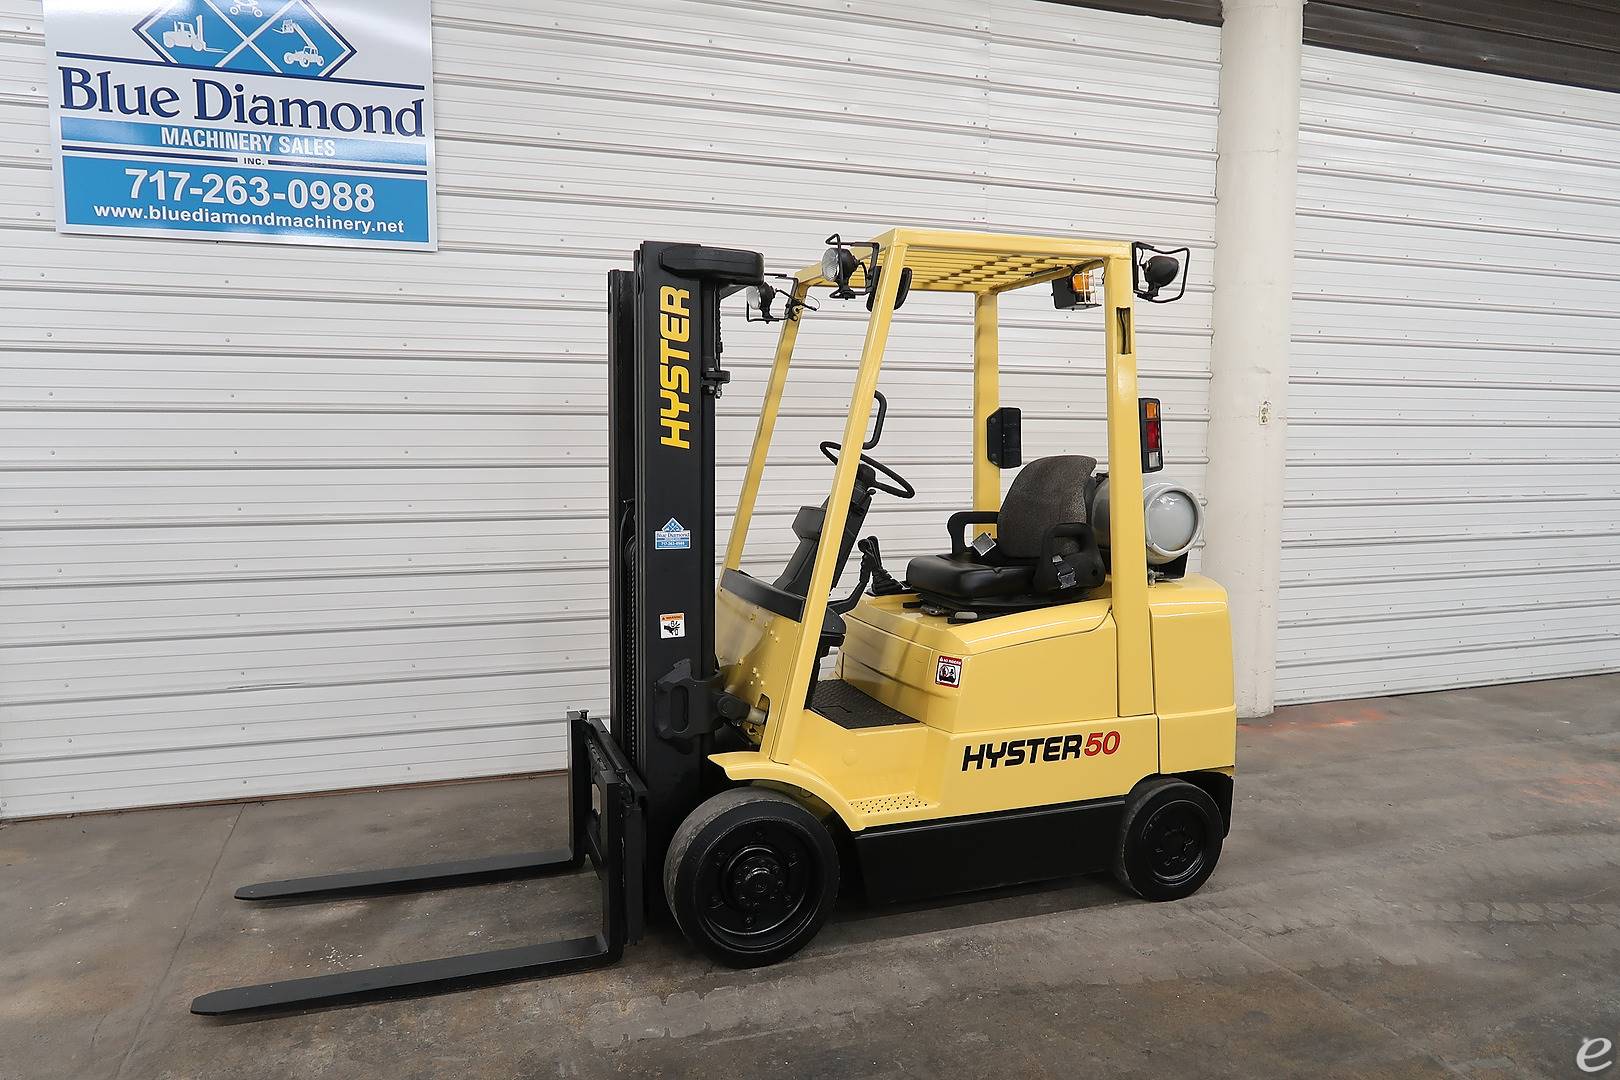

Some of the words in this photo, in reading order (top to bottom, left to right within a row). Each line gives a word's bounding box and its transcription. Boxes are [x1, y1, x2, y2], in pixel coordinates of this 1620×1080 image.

[58, 66, 180, 118] Blue
[192, 78, 426, 137] Diamond
[161, 126, 274, 152] MACHINERY
[278, 135, 336, 157] SALES
[243, 157, 265, 166] INC.
[125, 168, 375, 213] 717-263-0988
[94, 204, 405, 235] www.bluediamondmachinery.net
[660, 285, 690, 450] HYSTER
[962, 734, 1083, 771] HYSTER
